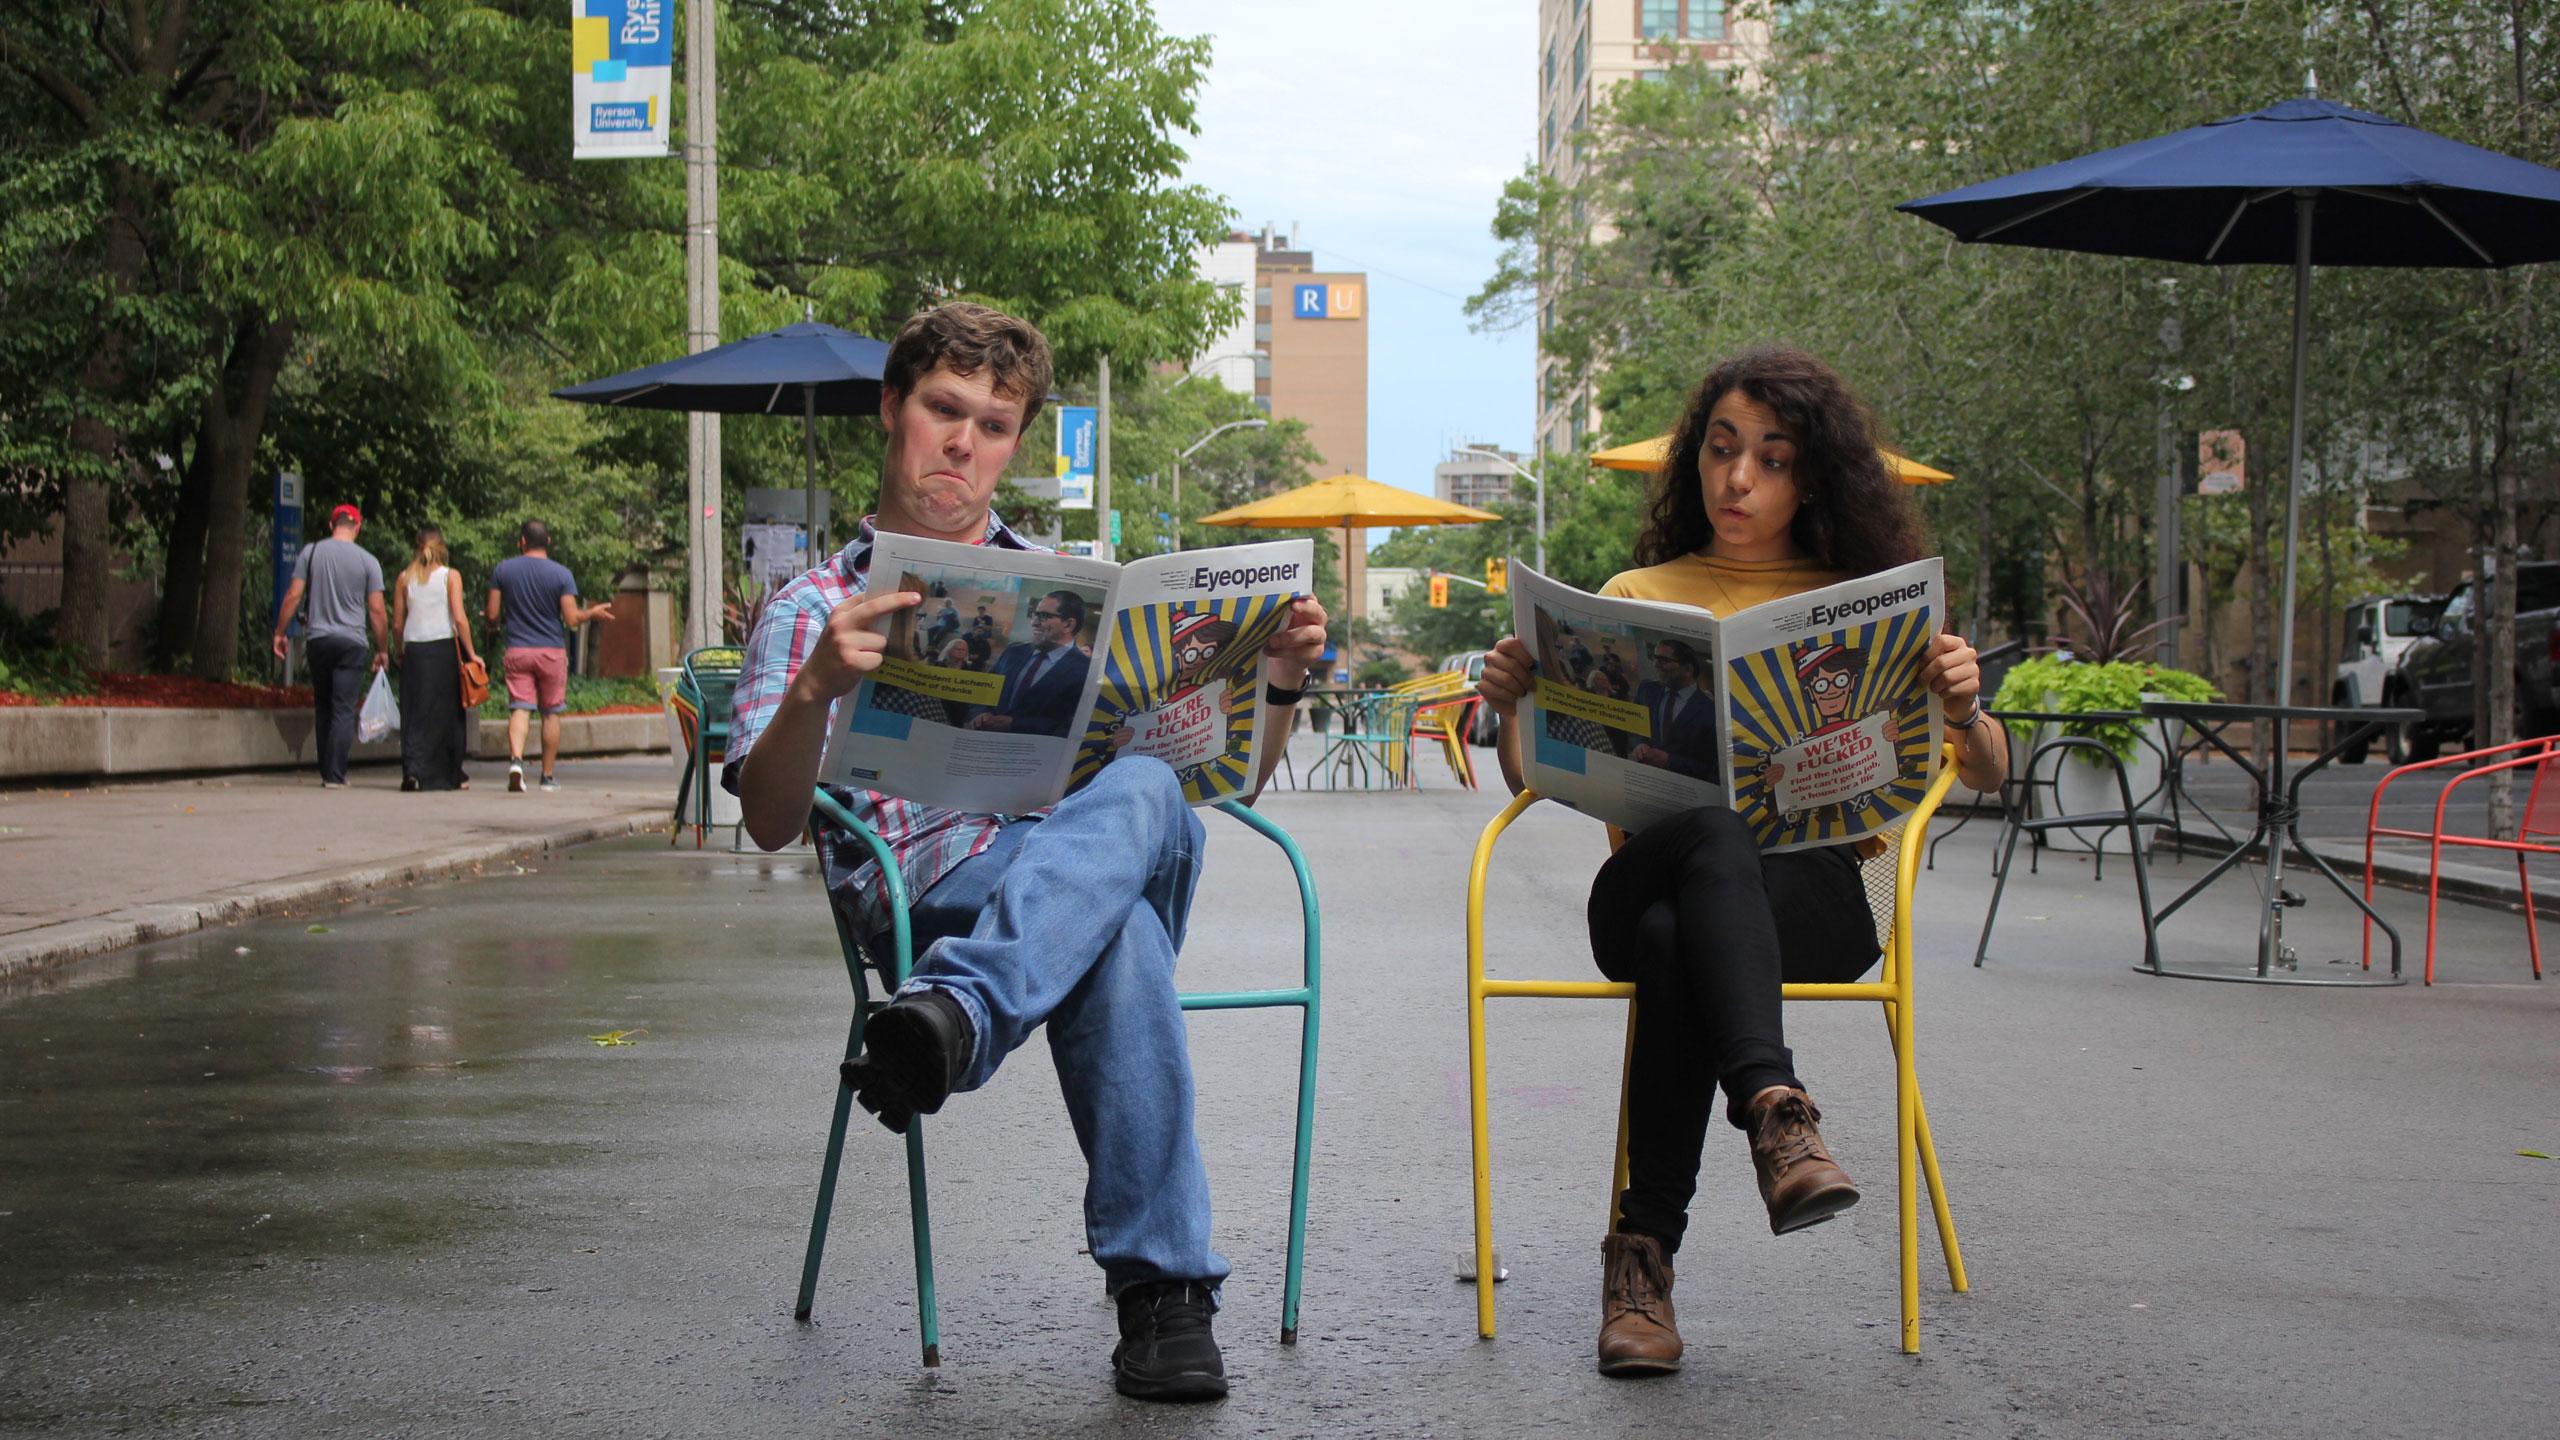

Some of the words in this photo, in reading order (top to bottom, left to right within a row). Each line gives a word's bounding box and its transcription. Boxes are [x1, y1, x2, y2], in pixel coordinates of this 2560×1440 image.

[595, 106, 636, 121] Ryerson
[595, 118, 646, 131] University
[1195, 563, 1300, 592] Eyeopener
[1811, 580, 1928, 626] Eyeopener
[1144, 705, 1212, 741] FUCKED
[1157, 692, 1206, 726] WE'RE
[1796, 736, 1873, 773] FUCKED
[1803, 726, 1863, 758] WE'RE
[1790, 774, 1812, 786] Find
[1813, 770, 1831, 780] the
[1832, 750, 1877, 775] Millennial
[1790, 783, 1812, 794] who
[1814, 778, 1838, 789] can't
[1840, 772, 1855, 785] get
[1808, 787, 1839, 800] house
[1840, 784, 1851, 792] or
[1860, 773, 1875, 785] life
